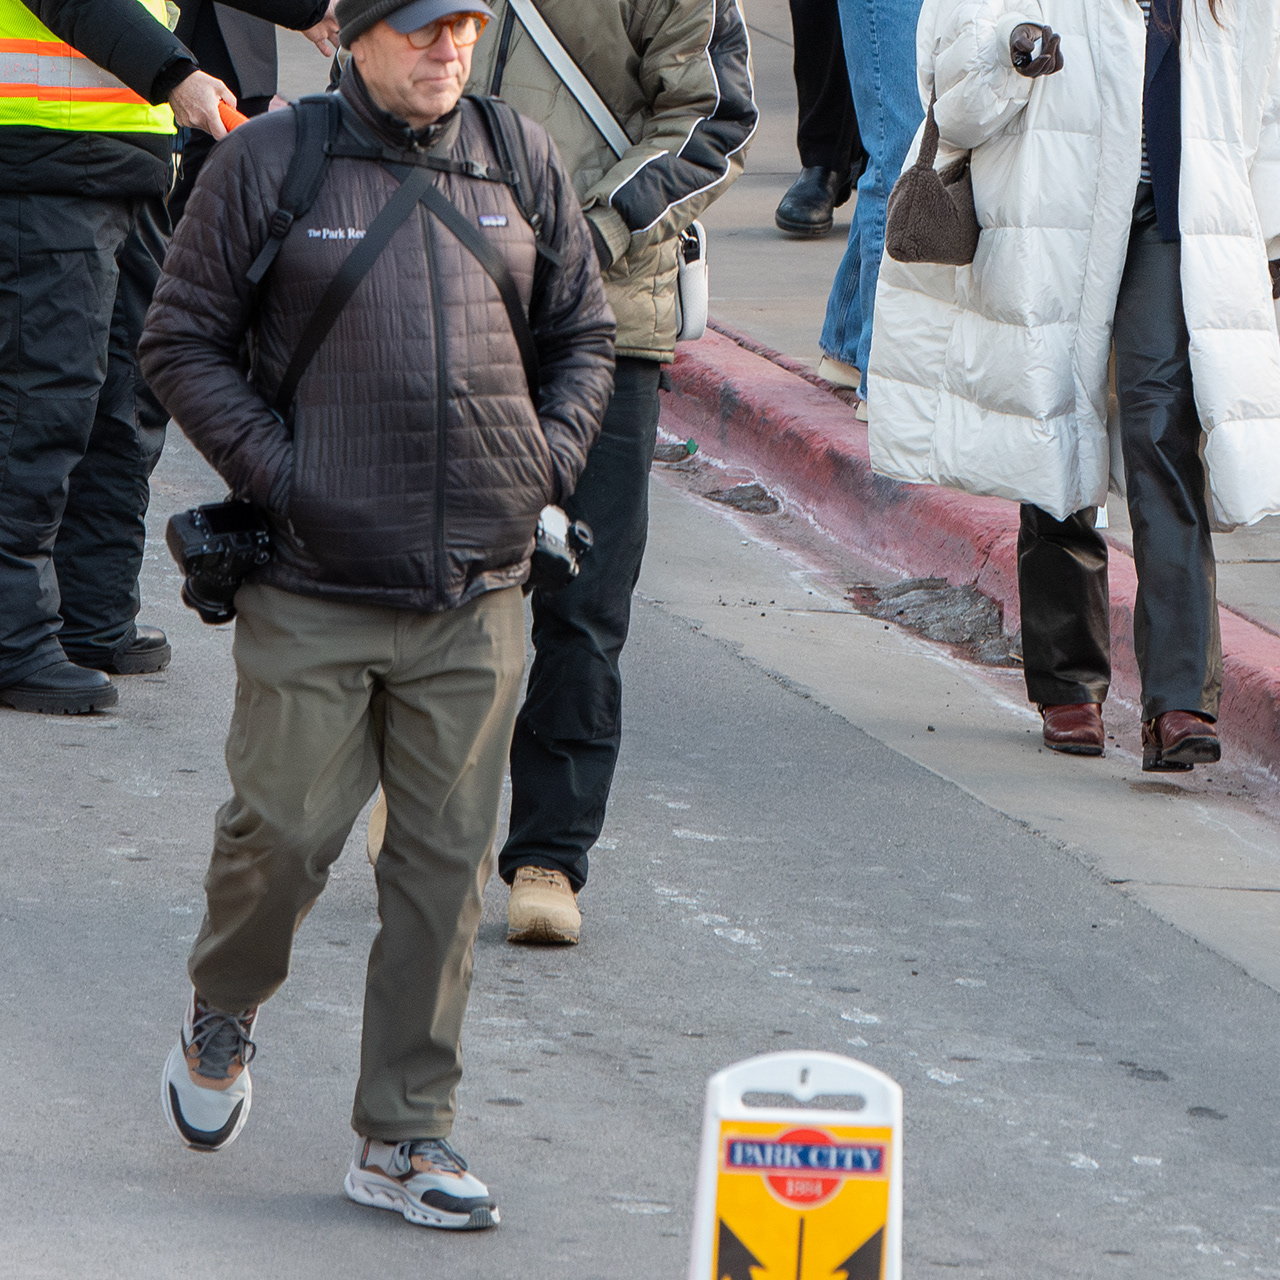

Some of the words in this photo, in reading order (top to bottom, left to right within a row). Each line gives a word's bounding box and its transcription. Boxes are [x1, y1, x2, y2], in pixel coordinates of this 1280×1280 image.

[322, 227, 346, 240] Park
[733, 1142, 801, 1169] PARK
[808, 1144, 879, 1171] CITY
